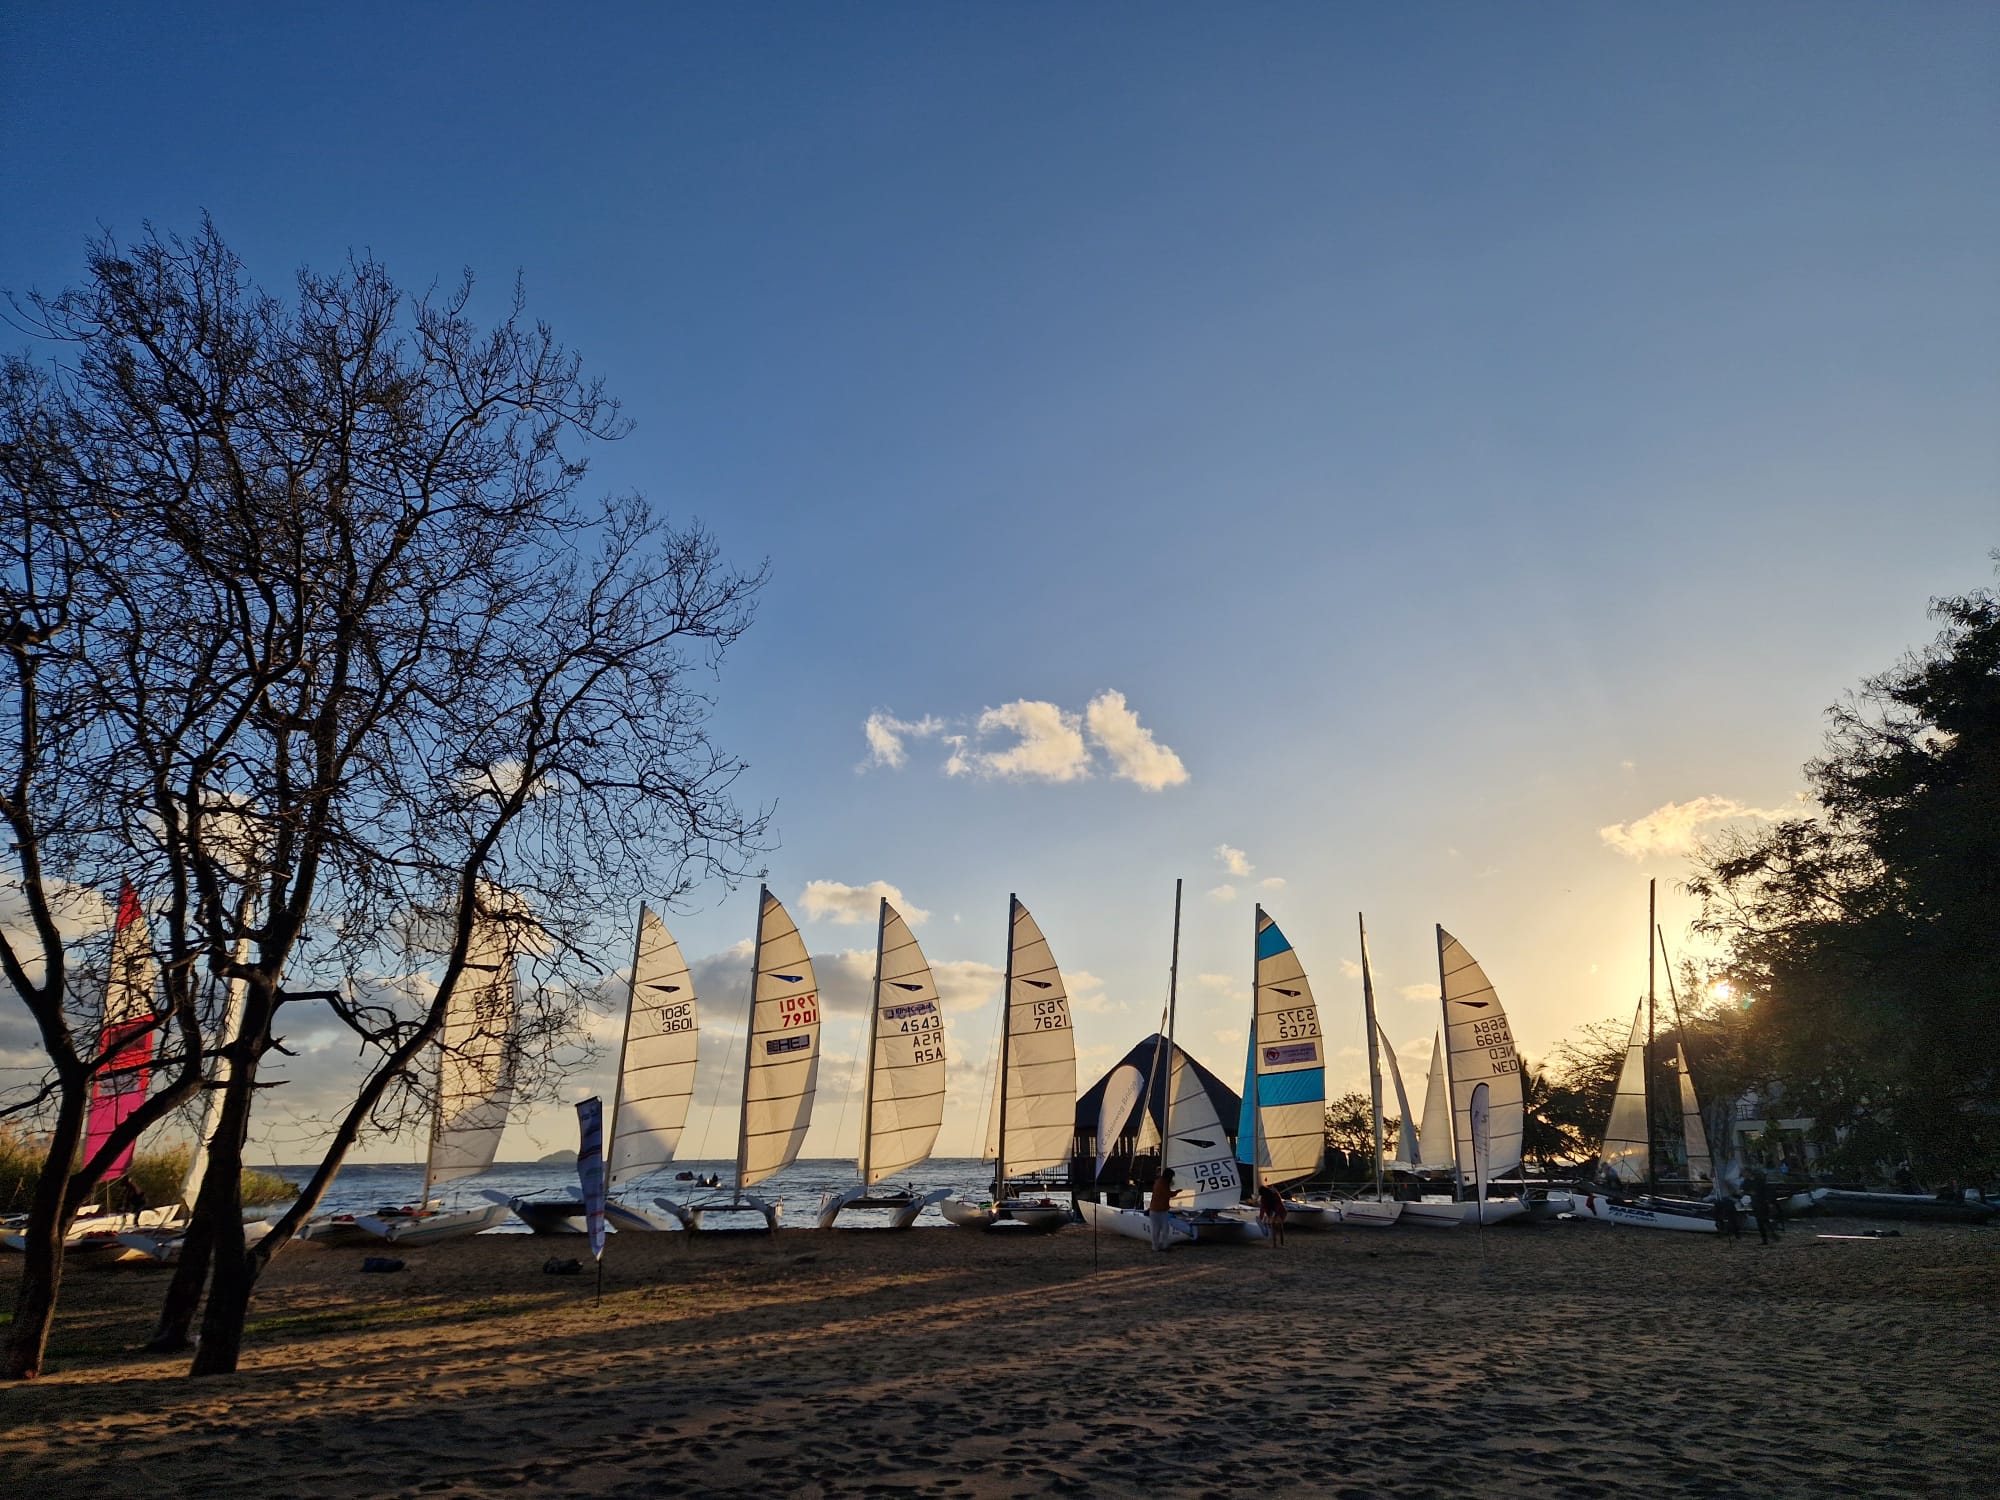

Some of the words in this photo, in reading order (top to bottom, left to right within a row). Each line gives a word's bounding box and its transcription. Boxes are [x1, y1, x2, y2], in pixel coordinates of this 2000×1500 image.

[662, 1016, 692, 1033] 3601
[782, 1008, 817, 1028] 7901
[901, 1016, 940, 1033] 4543
[1033, 1013, 1067, 1030] 7621
[1280, 1023, 1317, 1039] 5372
[1476, 1030, 1510, 1047] 6684
[915, 1047, 943, 1063] RSA
[1491, 1059, 1518, 1074] NED
[1196, 1174, 1236, 1193] 7951
